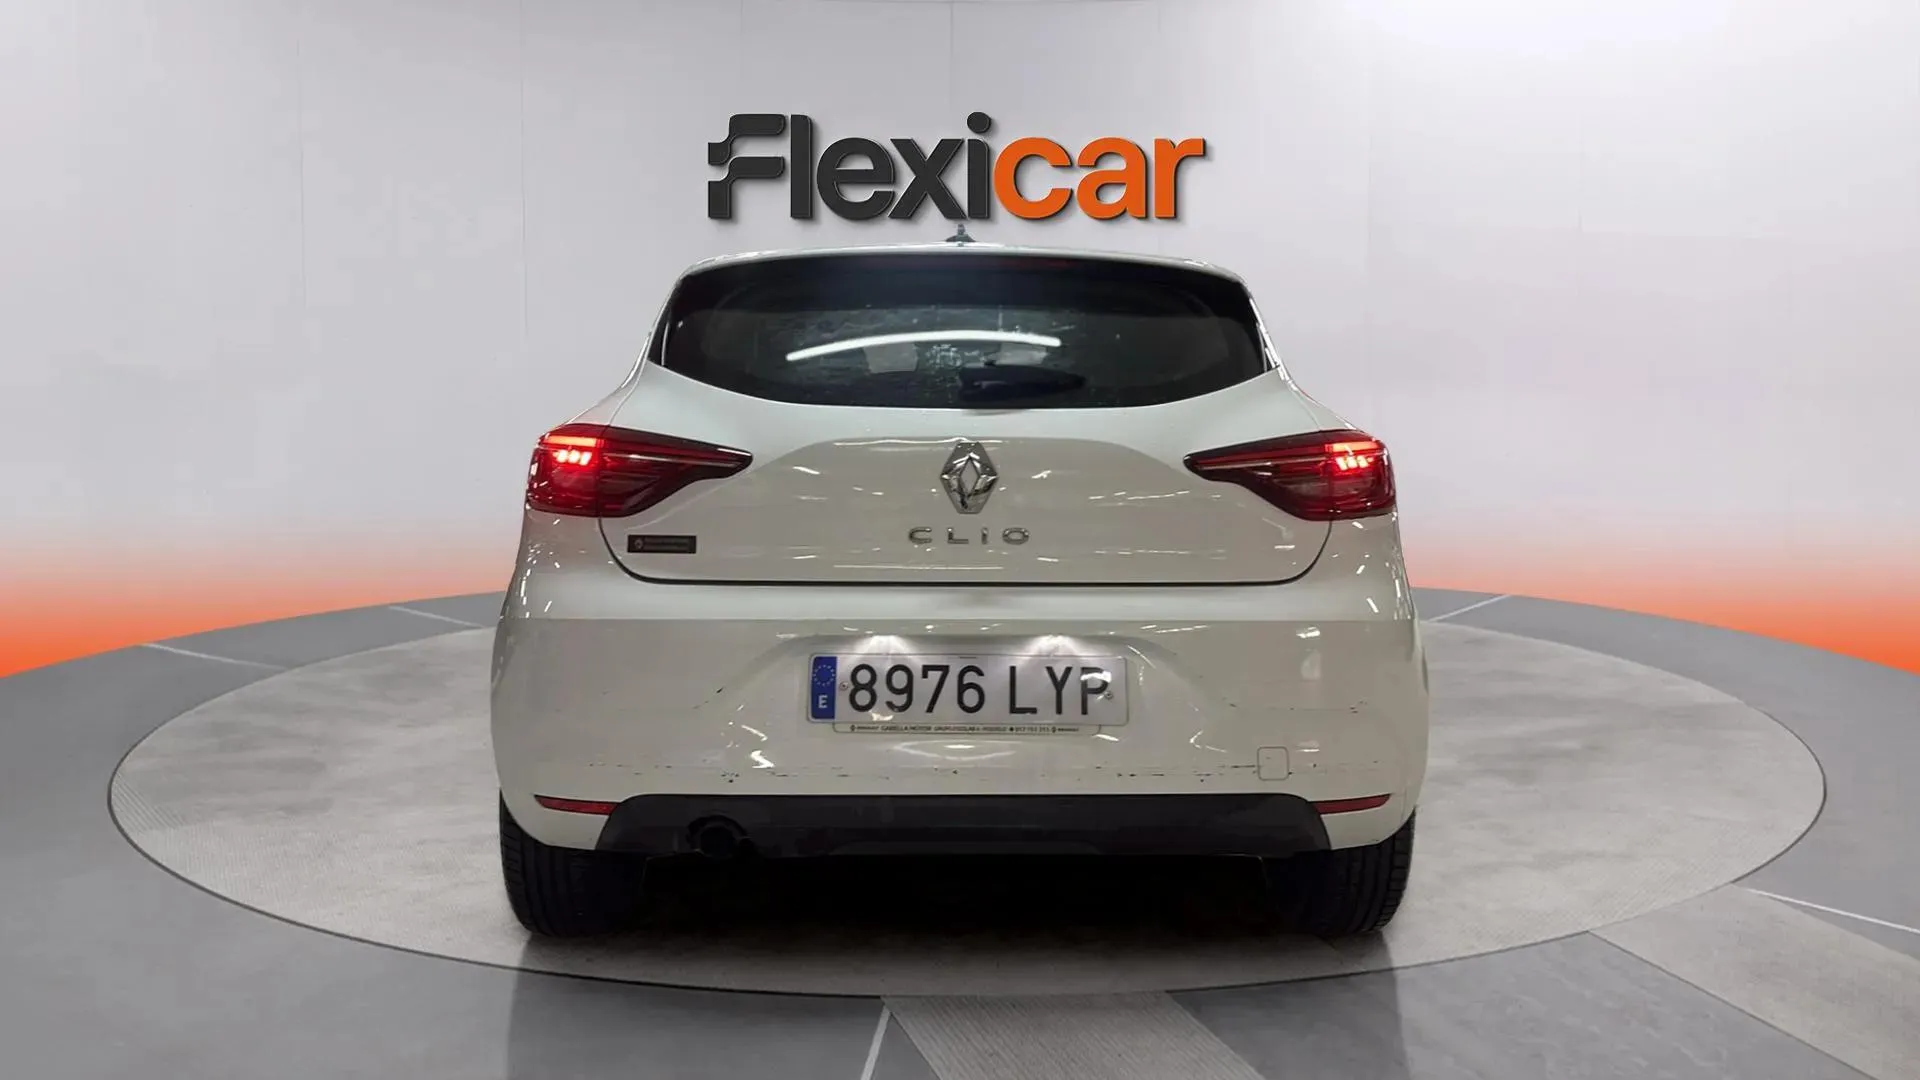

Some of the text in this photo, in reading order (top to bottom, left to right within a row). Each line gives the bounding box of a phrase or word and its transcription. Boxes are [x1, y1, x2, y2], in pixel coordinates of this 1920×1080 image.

[707, 111, 1206, 219] Flexicar
[907, 526, 1030, 545] CLIO
[818, 694, 828, 709] E
[848, 663, 1110, 716] 8976 LYP
